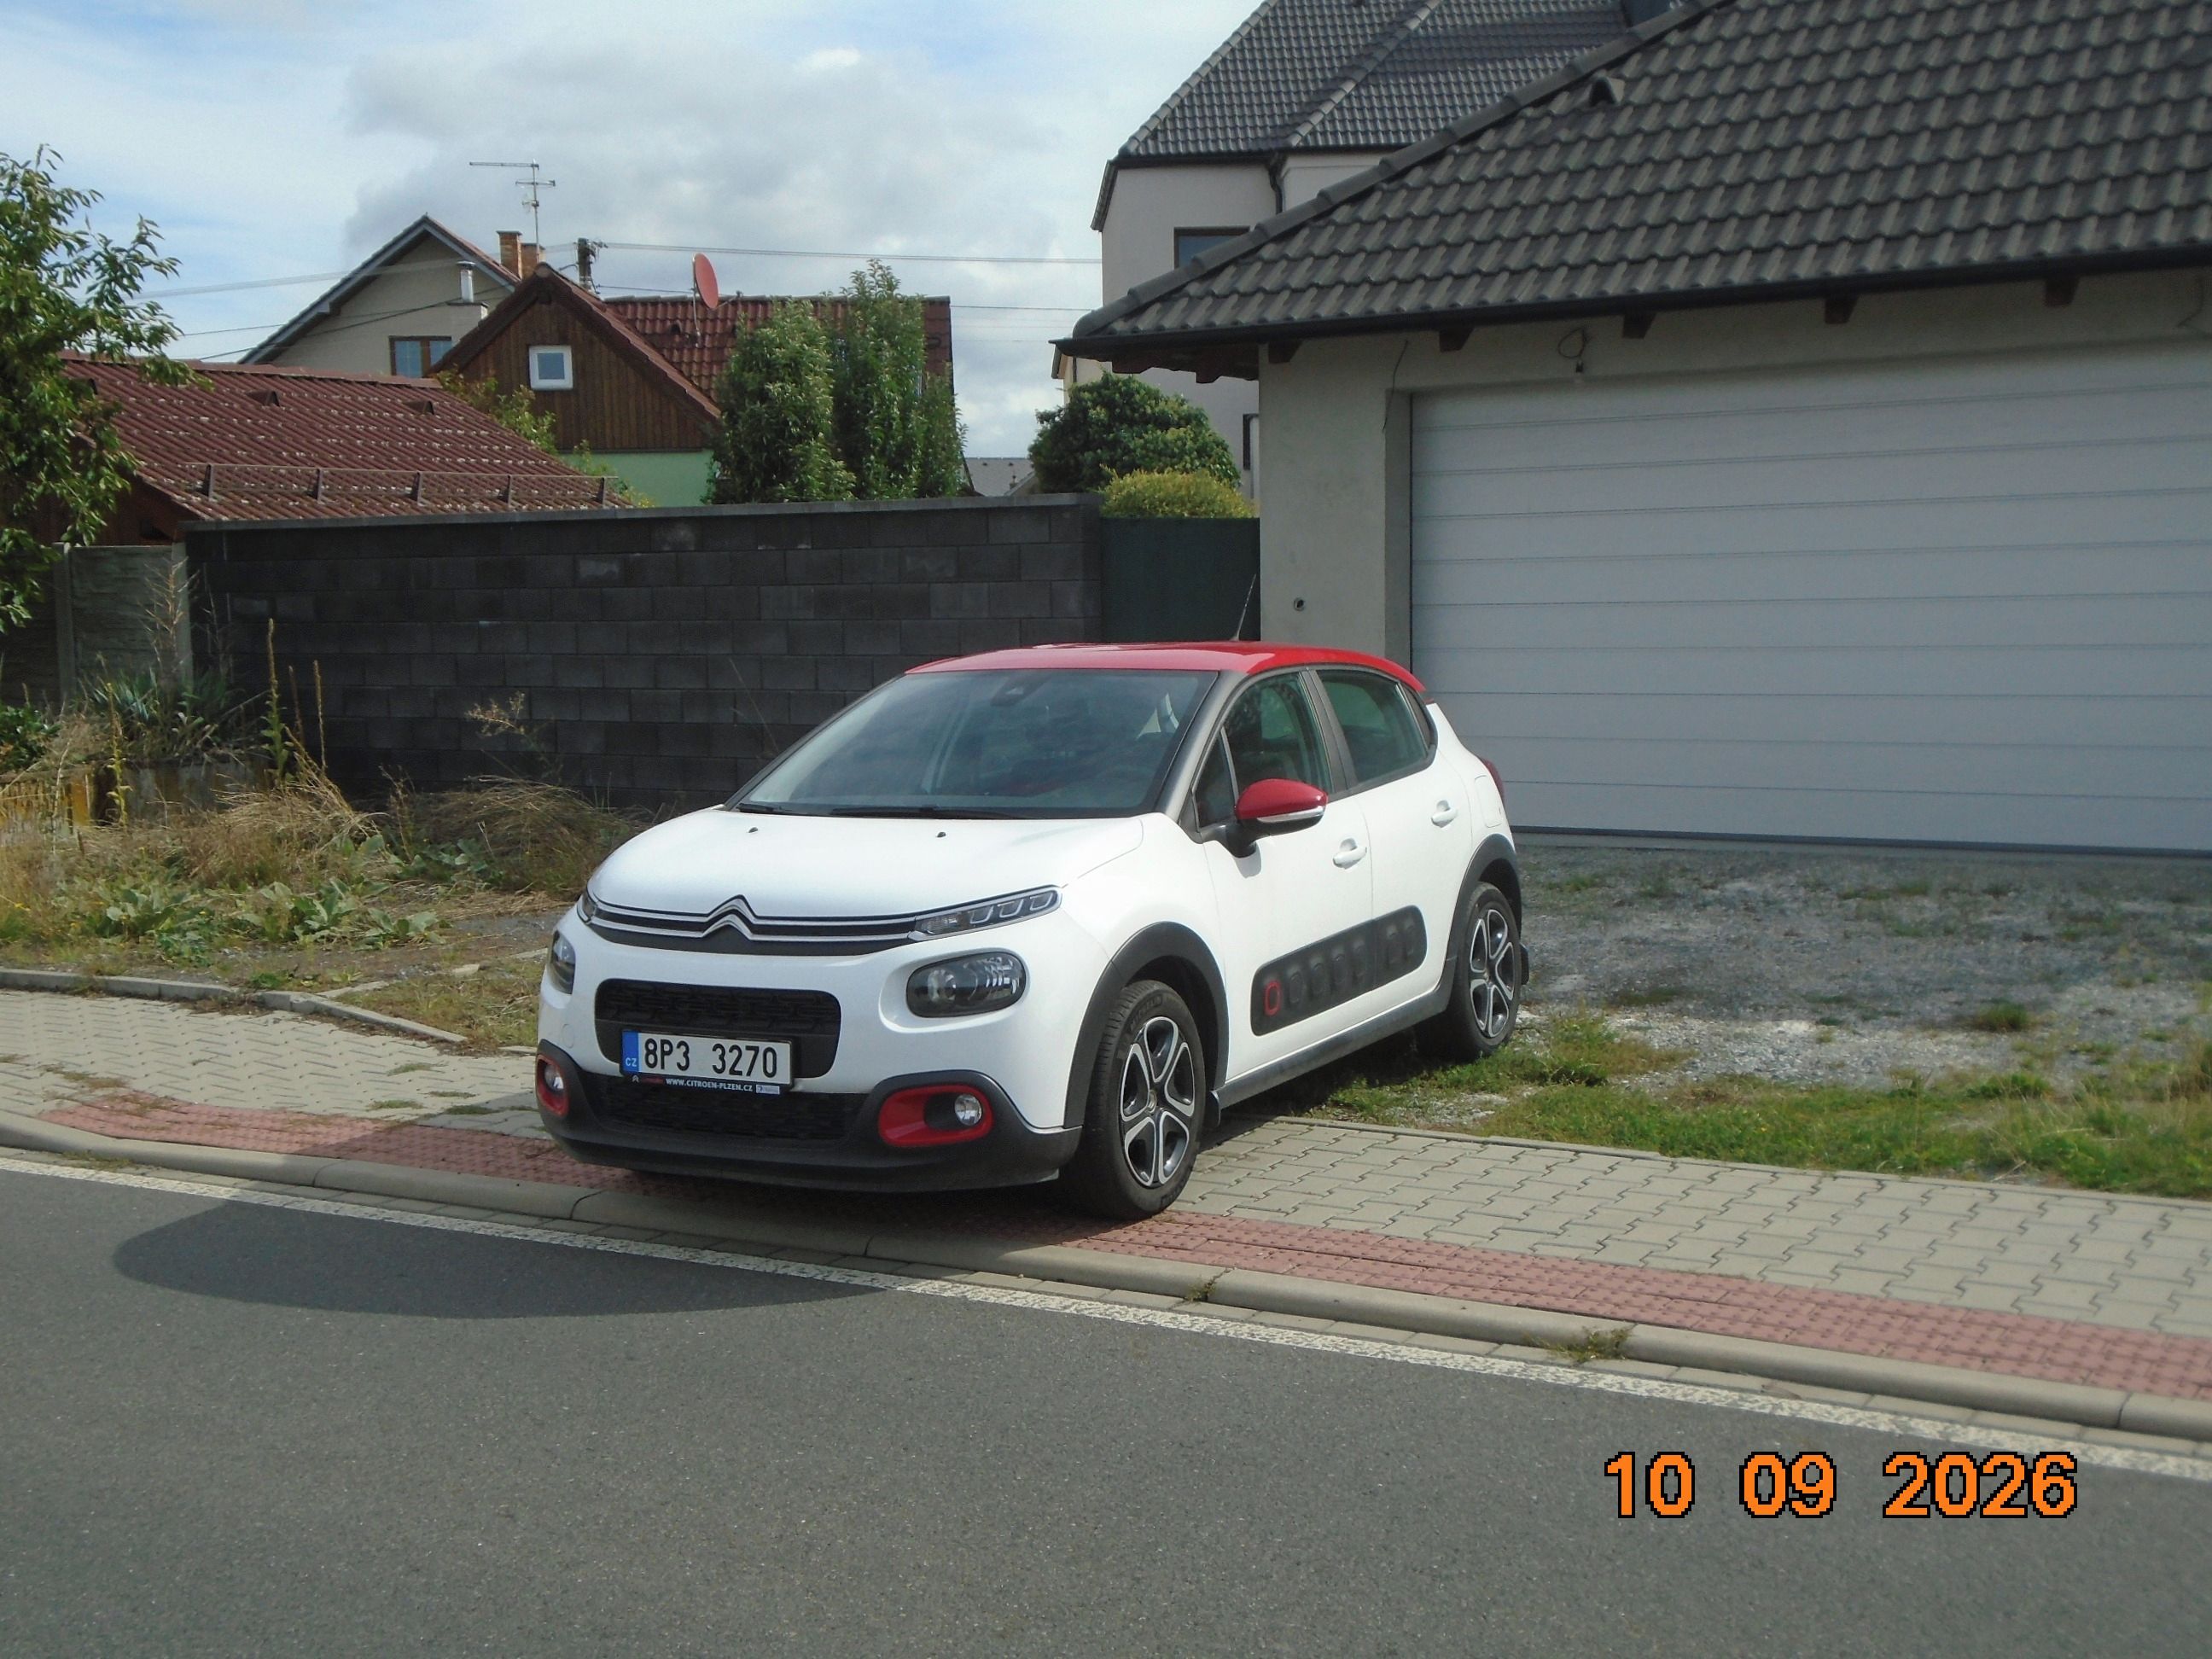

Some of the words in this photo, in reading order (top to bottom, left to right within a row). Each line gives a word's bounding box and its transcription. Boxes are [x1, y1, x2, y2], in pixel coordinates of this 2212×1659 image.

[625, 1057, 637, 1067] CZ
[644, 1038, 690, 1071] 8P3
[712, 1043, 777, 1079] 3270
[666, 1078, 753, 1092] WWW.CITROEN-PLZEN.CZ
